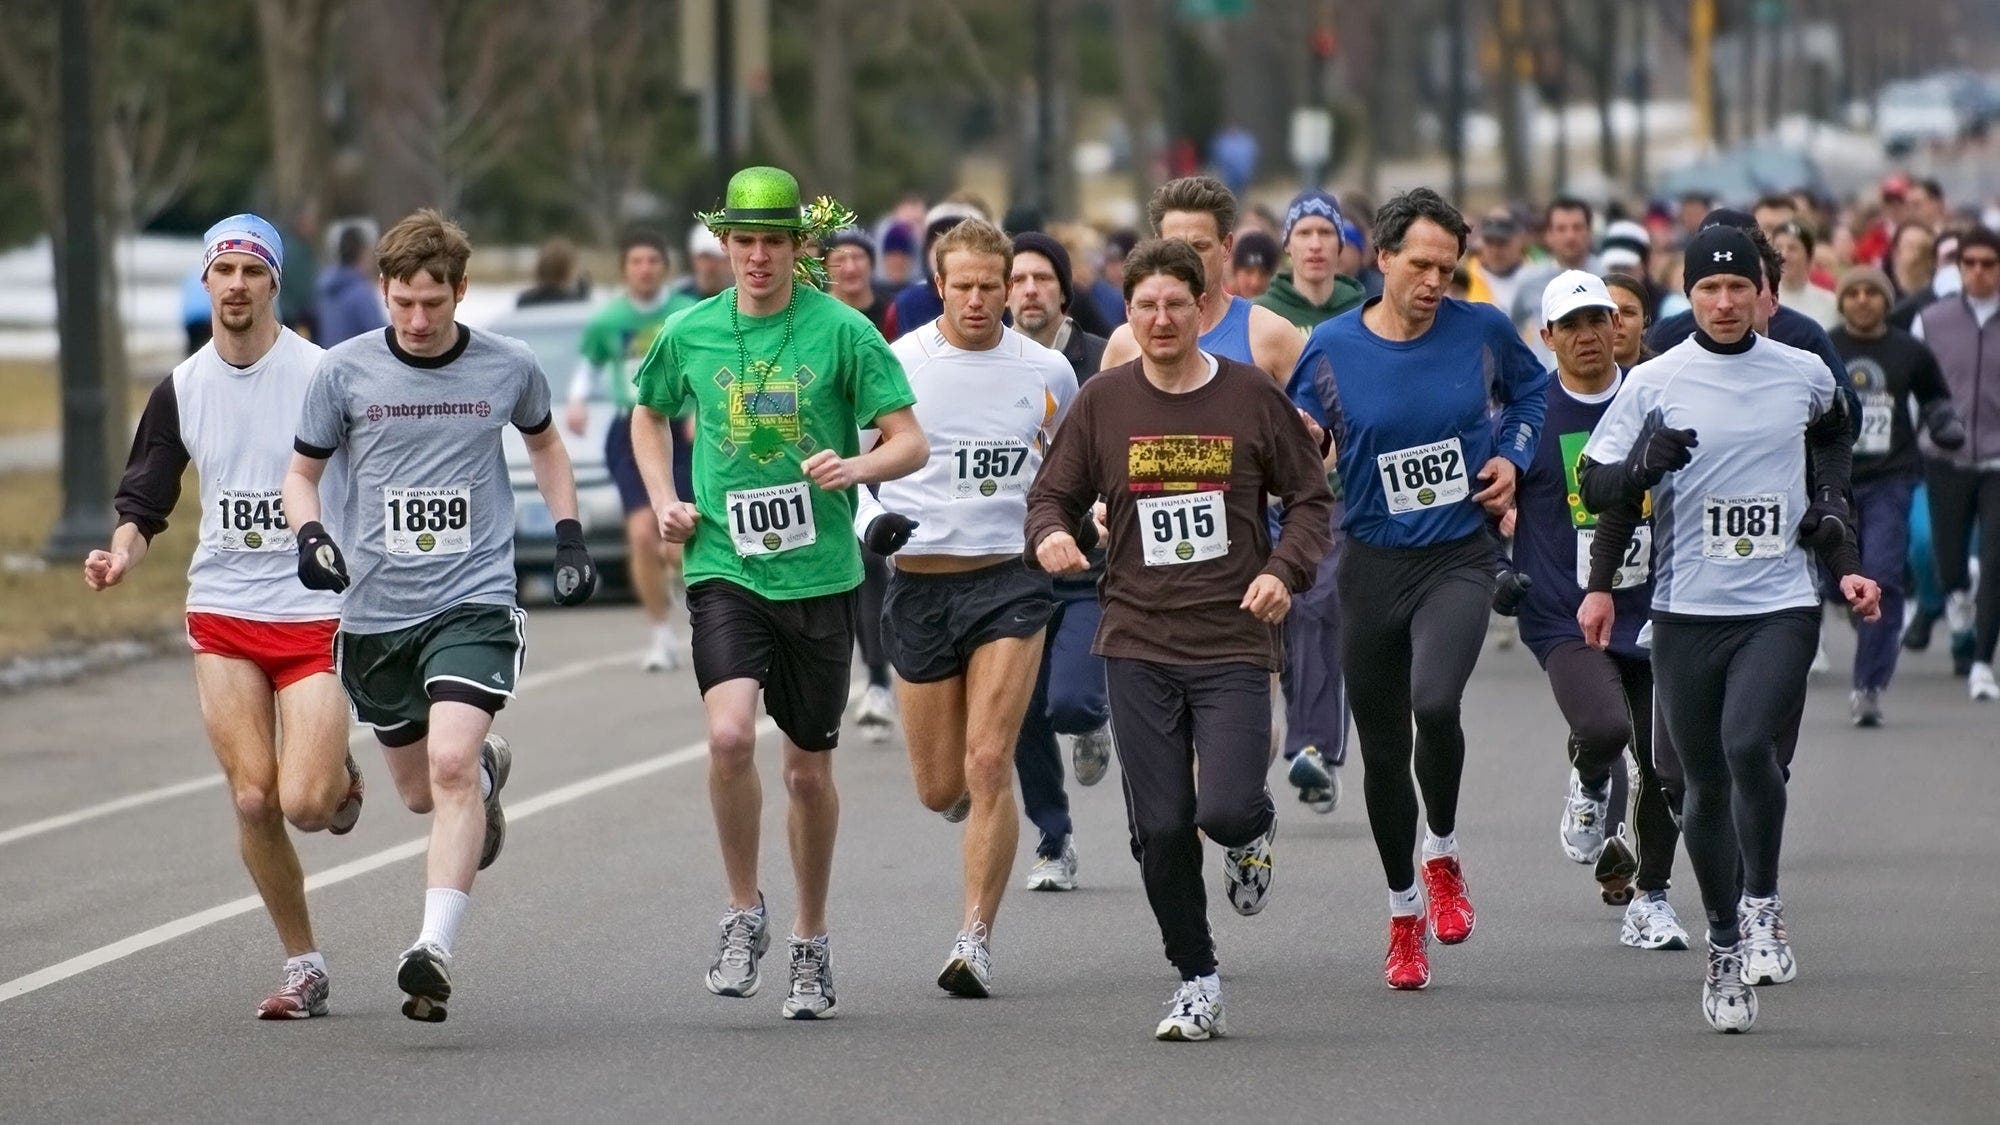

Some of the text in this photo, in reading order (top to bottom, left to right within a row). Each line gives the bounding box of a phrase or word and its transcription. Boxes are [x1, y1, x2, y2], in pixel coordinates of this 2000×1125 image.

[384, 402, 474, 419] Independent
[954, 447, 1029, 479] 1357
[1400, 447, 1430, 459] HUMAN
[1431, 443, 1450, 452] RACE
[1383, 449, 1464, 493] 1862
[406, 490, 437, 498] HUMAN
[440, 489, 460, 497] RACE
[747, 490, 777, 499] HUMAN
[778, 486, 799, 495] RACE
[1161, 498, 1191, 507] HUMAN
[1193, 495, 1215, 503] RACE
[219, 498, 290, 530] 1843
[388, 497, 467, 532] 1839
[731, 494, 806, 535] 1001
[1152, 504, 1214, 543] 915
[1707, 504, 1780, 537] 1081
